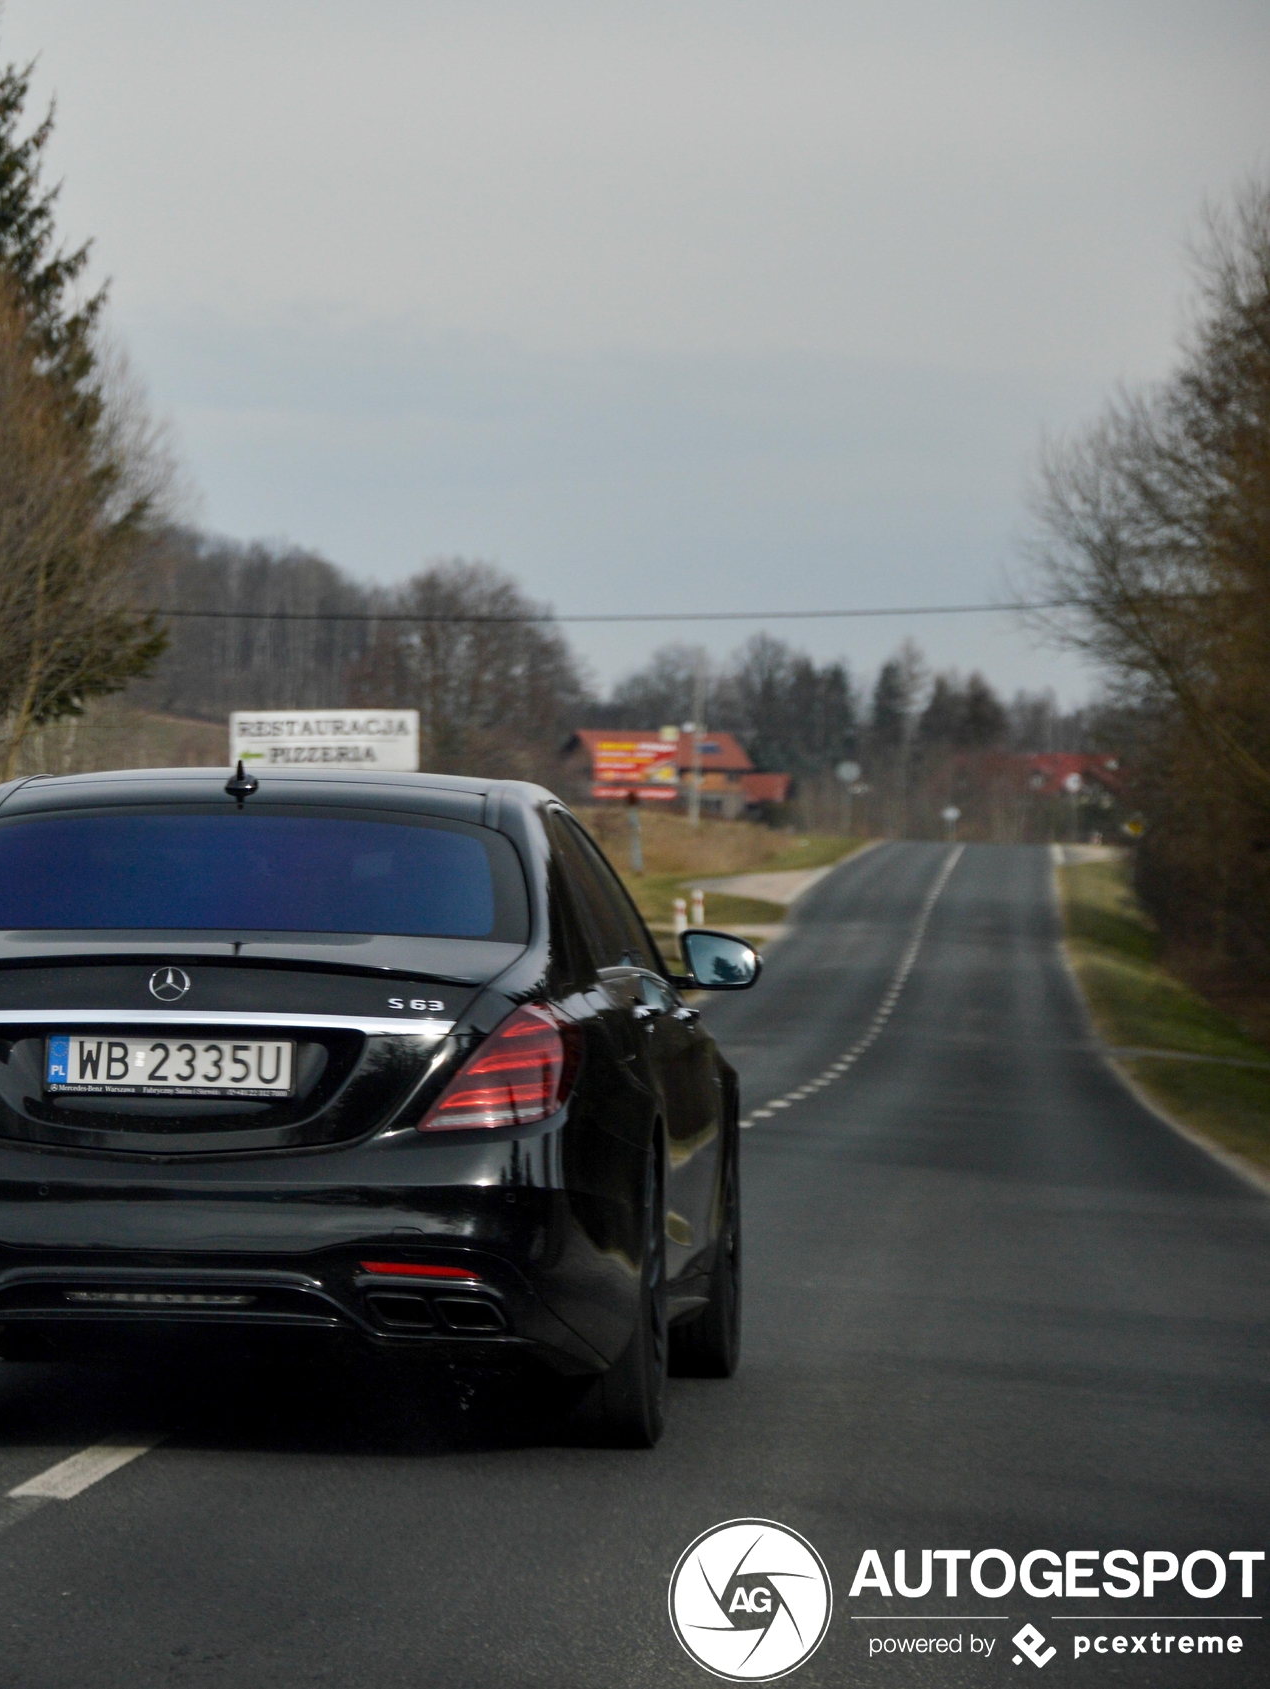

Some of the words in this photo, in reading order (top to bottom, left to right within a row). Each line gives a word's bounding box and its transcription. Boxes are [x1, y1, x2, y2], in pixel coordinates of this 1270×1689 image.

[238, 718, 410, 737] RESTAURACJA
[270, 746, 378, 764] PIZZERIA
[388, 998, 405, 1010] S
[410, 999, 446, 1012] 63
[50, 1065, 66, 1076] PL
[79, 1041, 129, 1080] WB
[148, 1043, 282, 1085] 2335U
[59, 1084, 103, 1092] Mercedes-Benz
[105, 1085, 136, 1093] Warszawa
